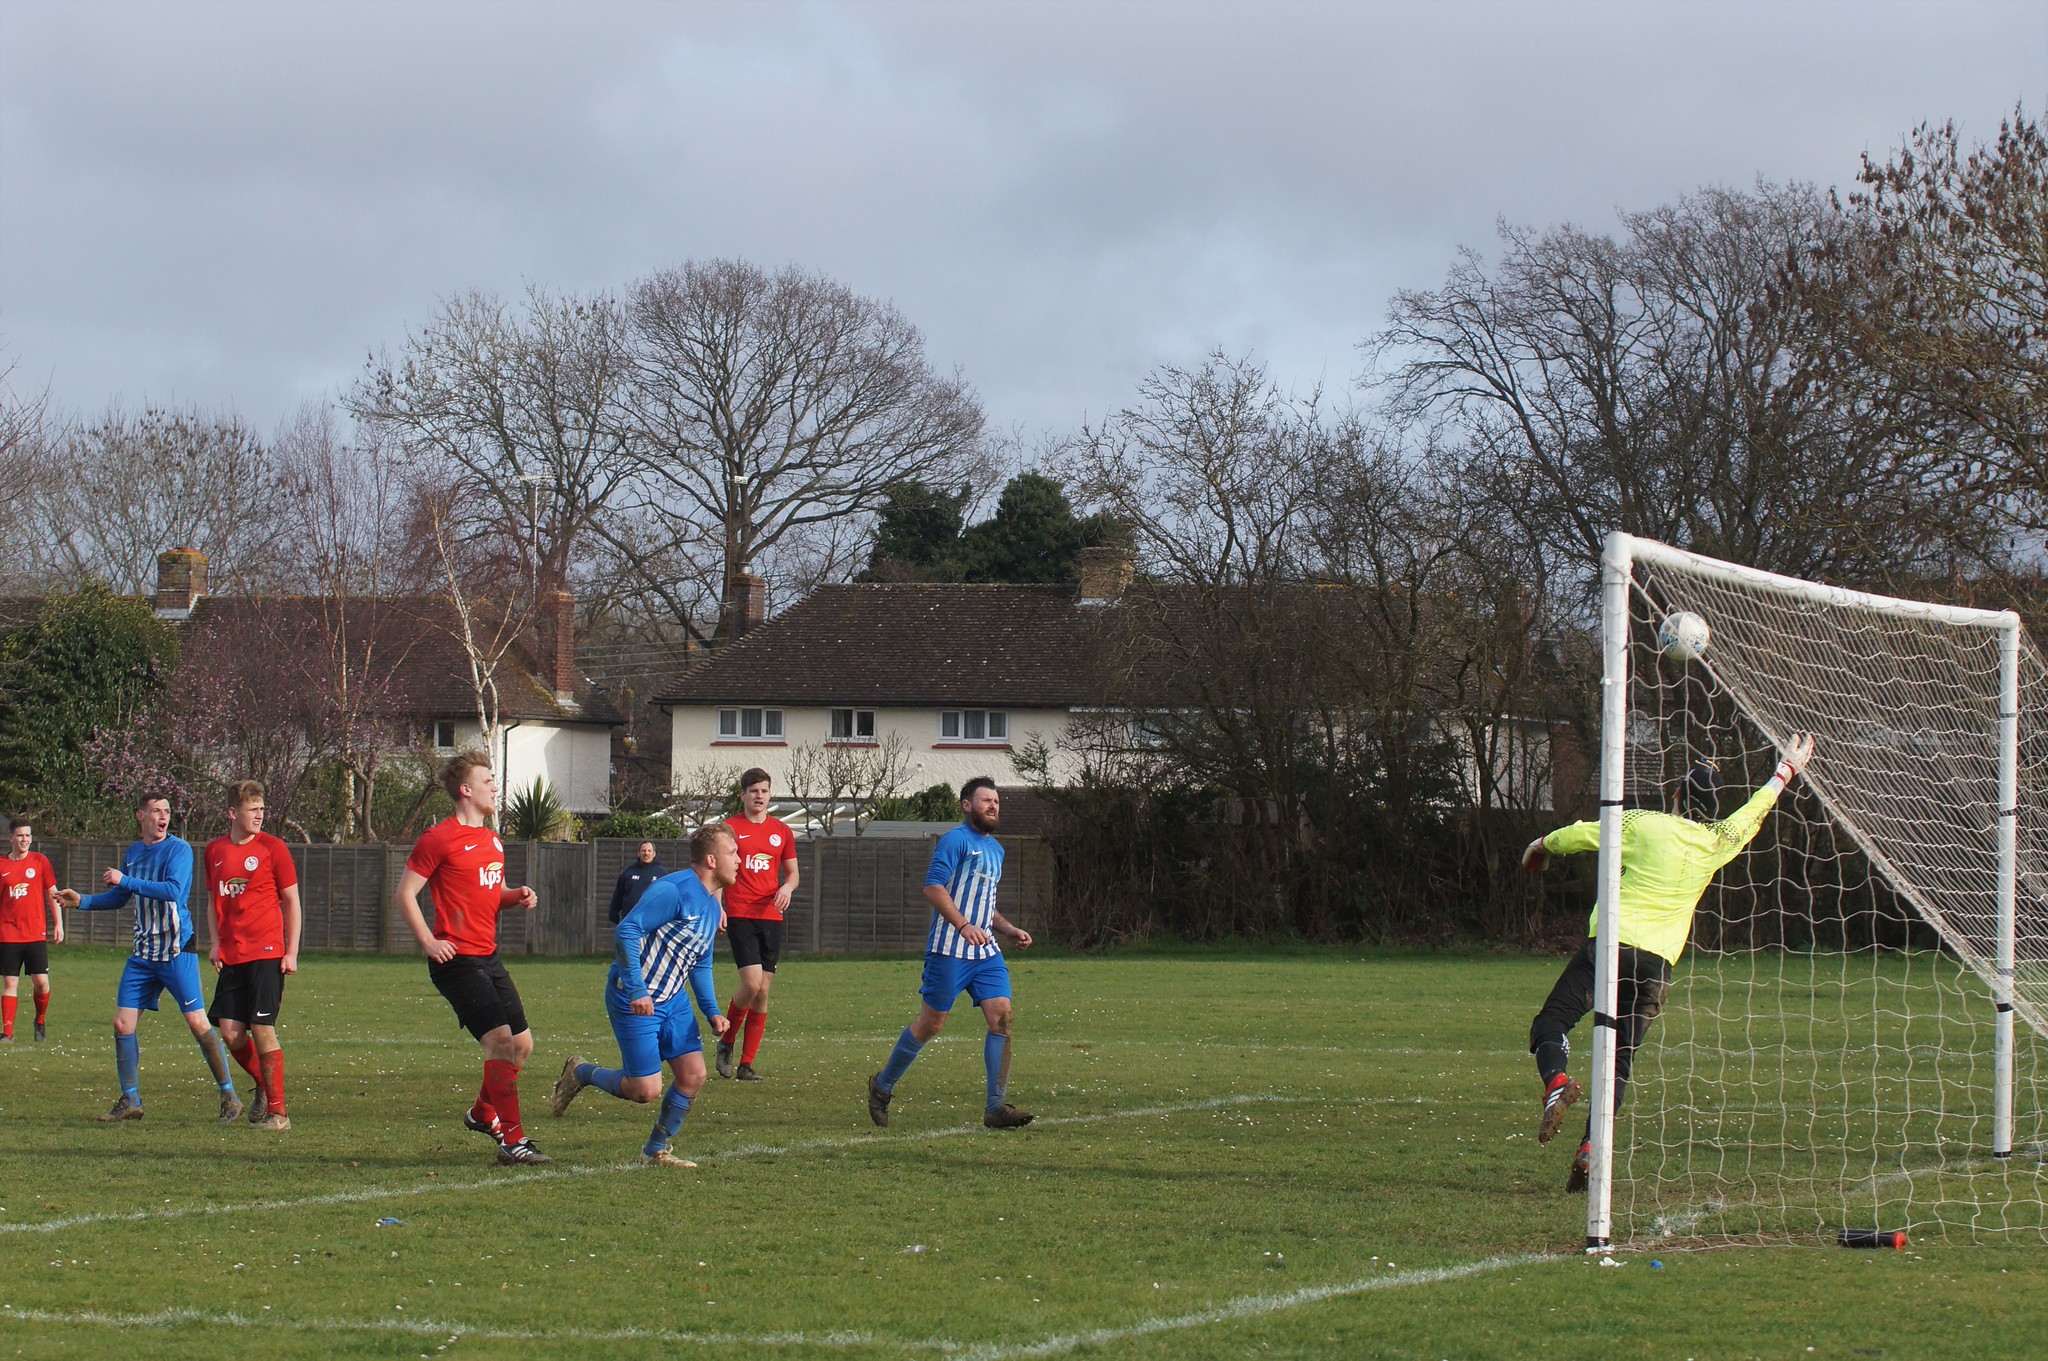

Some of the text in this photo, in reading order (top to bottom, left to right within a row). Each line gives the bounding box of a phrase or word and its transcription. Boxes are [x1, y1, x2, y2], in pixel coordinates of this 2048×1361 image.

[745, 854, 770, 873] kps
[479, 867, 502, 889] kps
[9, 885, 28, 899] kps
[219, 880, 247, 898] kps
